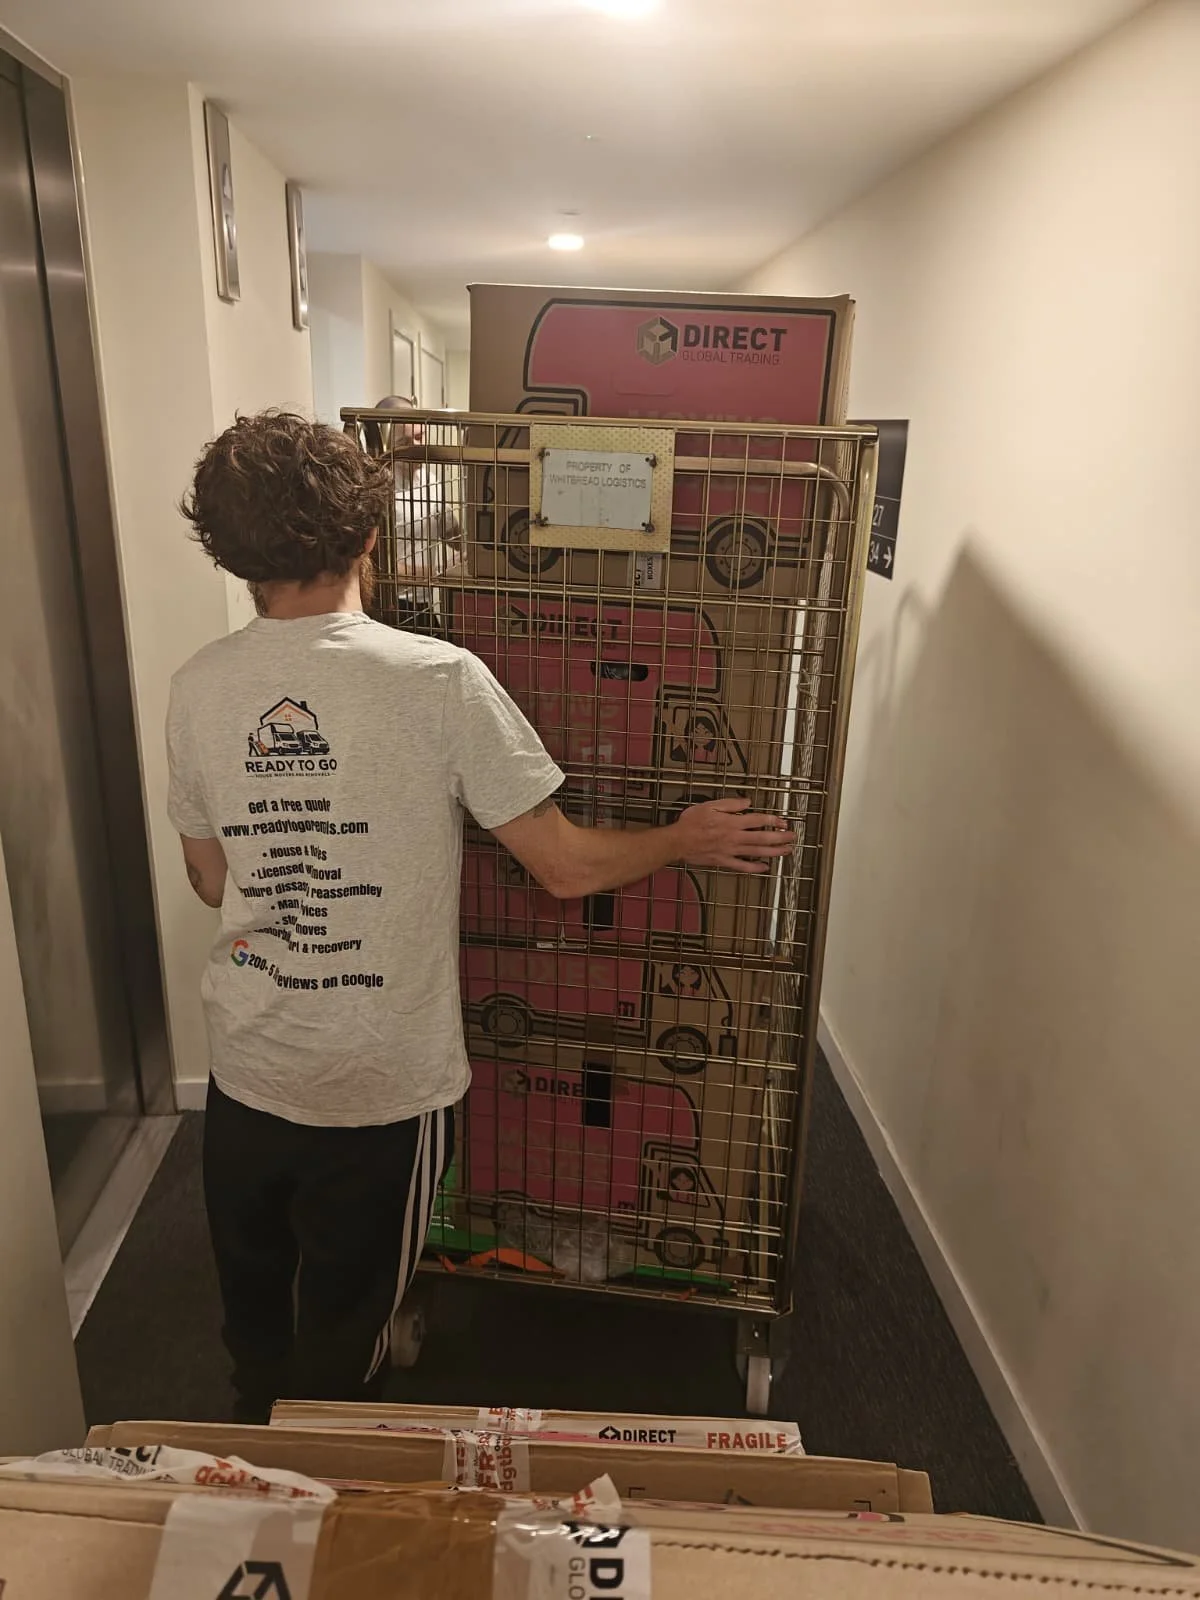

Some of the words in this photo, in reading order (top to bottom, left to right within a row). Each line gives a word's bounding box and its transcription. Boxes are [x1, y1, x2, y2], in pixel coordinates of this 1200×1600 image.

[683, 324, 788, 352] DIRECT
[682, 350, 727, 363] GLOBAL
[730, 352, 780, 366] TRADING
[566, 461, 612, 473] PROPERTY
[619, 463, 631, 473] OF
[550, 474, 599, 486] WHITBREAD
[602, 477, 647, 488] LOGISTICS
[245, 760, 295, 773] READY
[298, 759, 315, 771] TO
[319, 758, 338, 771] GO
[248, 799, 268, 814] Get
[270, 800, 279, 812] a
[281, 797, 303, 812] free
[304, 797, 331, 813] quote
[269, 845, 303, 859] House
[256, 862, 305, 880] Licensed
[277, 898, 300, 911] Man
[295, 922, 328, 936] moves
[311, 939, 363, 954] recovery
[322, 974, 338, 989] on
[341, 973, 385, 988] Google
[622, 1429, 677, 1444] DIRECT
[707, 1432, 787, 1449] FRAGILE
